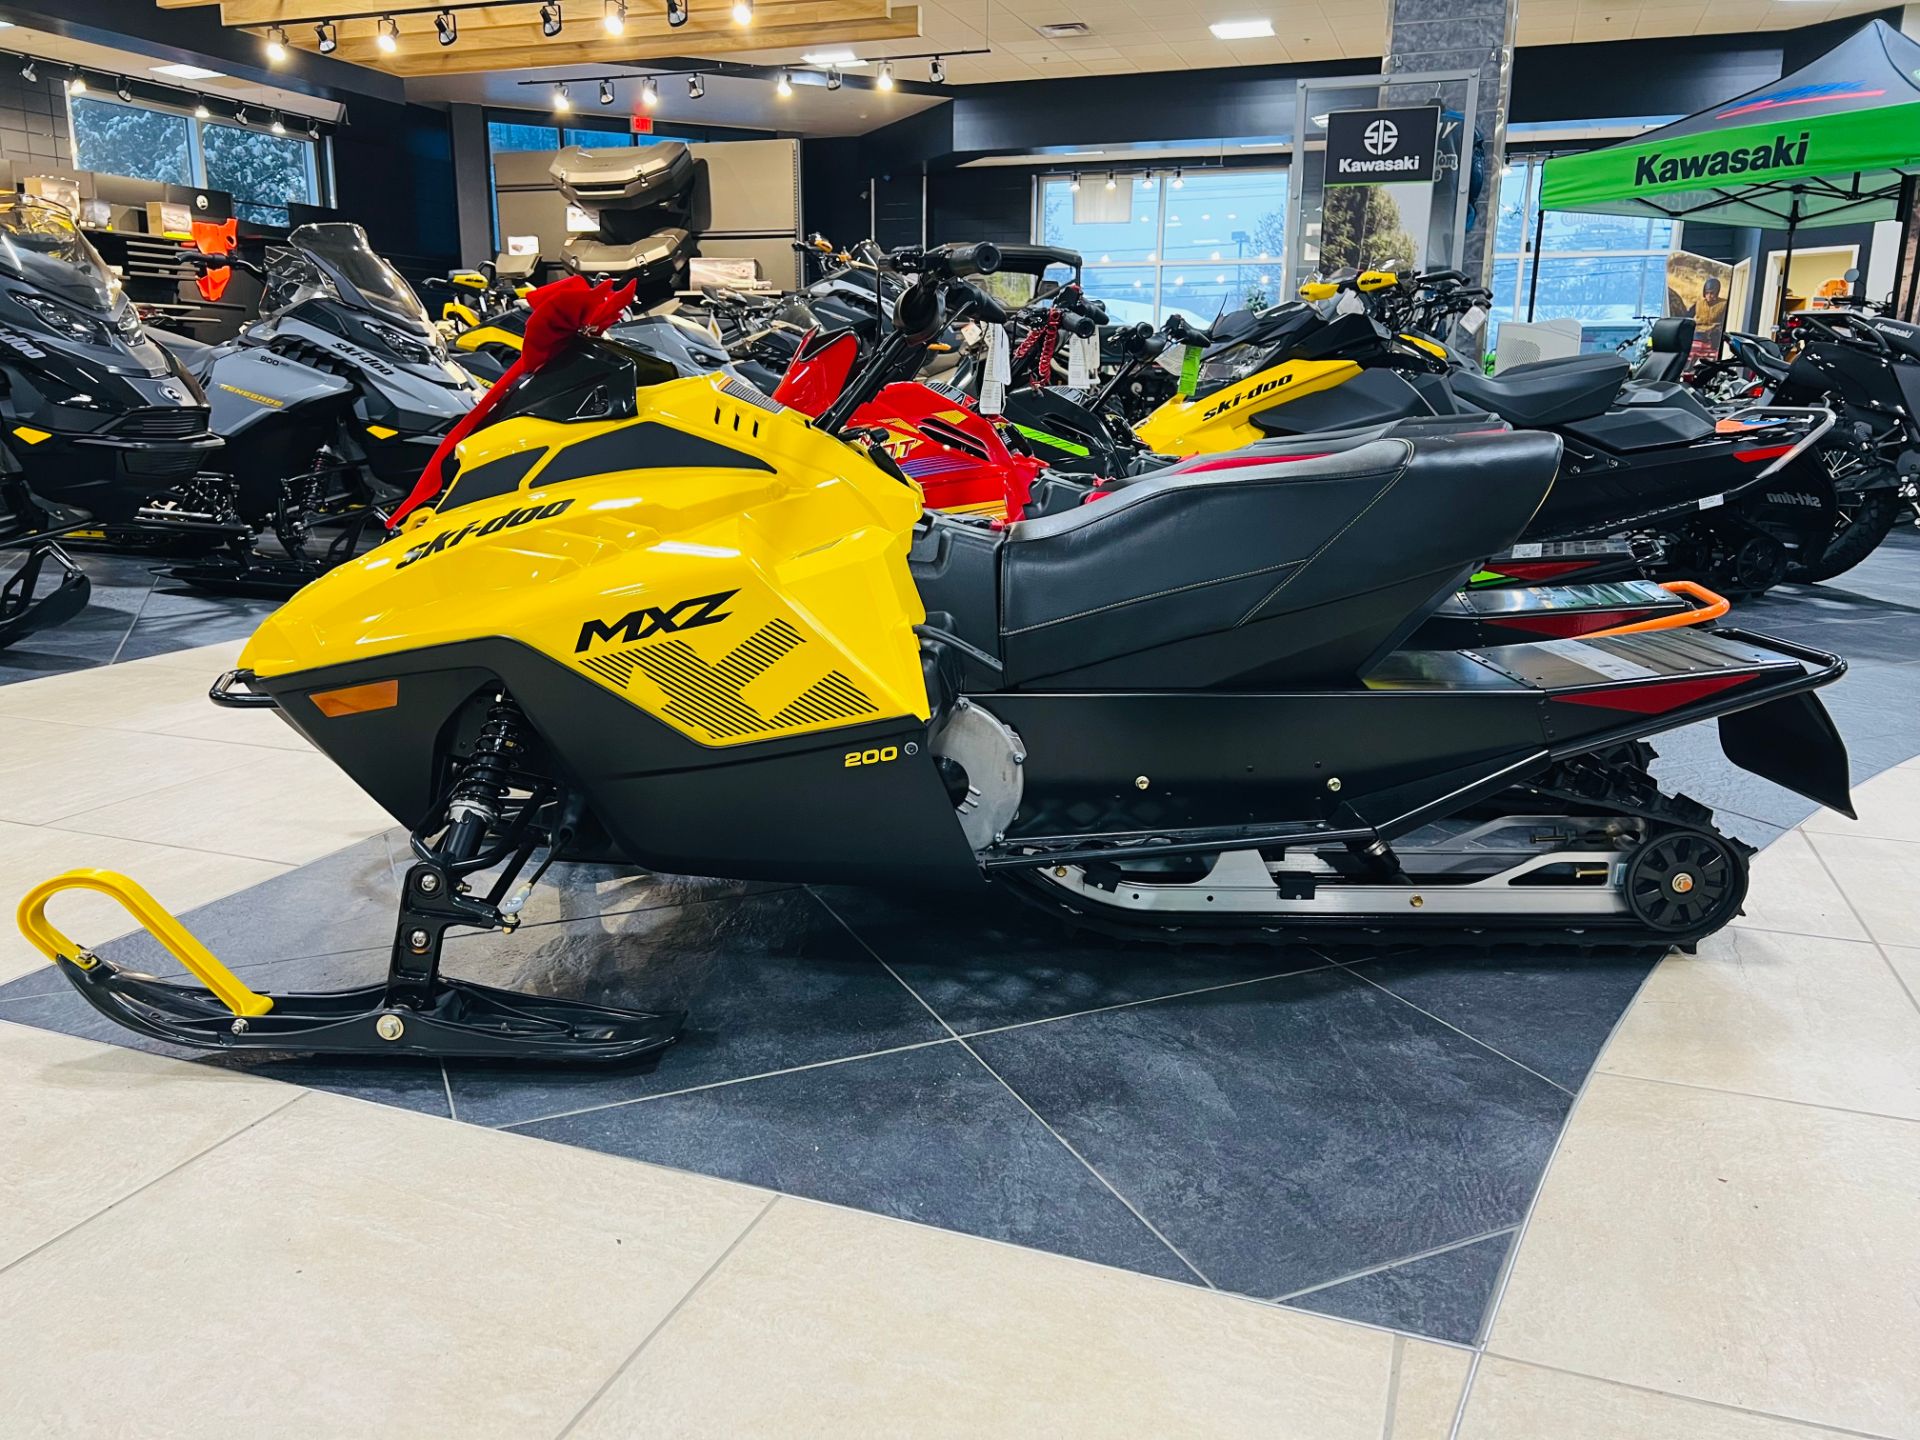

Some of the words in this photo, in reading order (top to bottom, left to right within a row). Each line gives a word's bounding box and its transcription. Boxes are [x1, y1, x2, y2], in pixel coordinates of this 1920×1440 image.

[1338, 155, 1420, 173] Kawasaki
[1634, 132, 1810, 186] Kawasaki
[1874, 322, 1914, 339] Kawasaki
[331, 342, 395, 376] ski-doo
[1202, 374, 1293, 421] ski-doo
[395, 499, 576, 570] ski-doo
[574, 588, 742, 653] MXZ
[844, 746, 898, 767] 200
